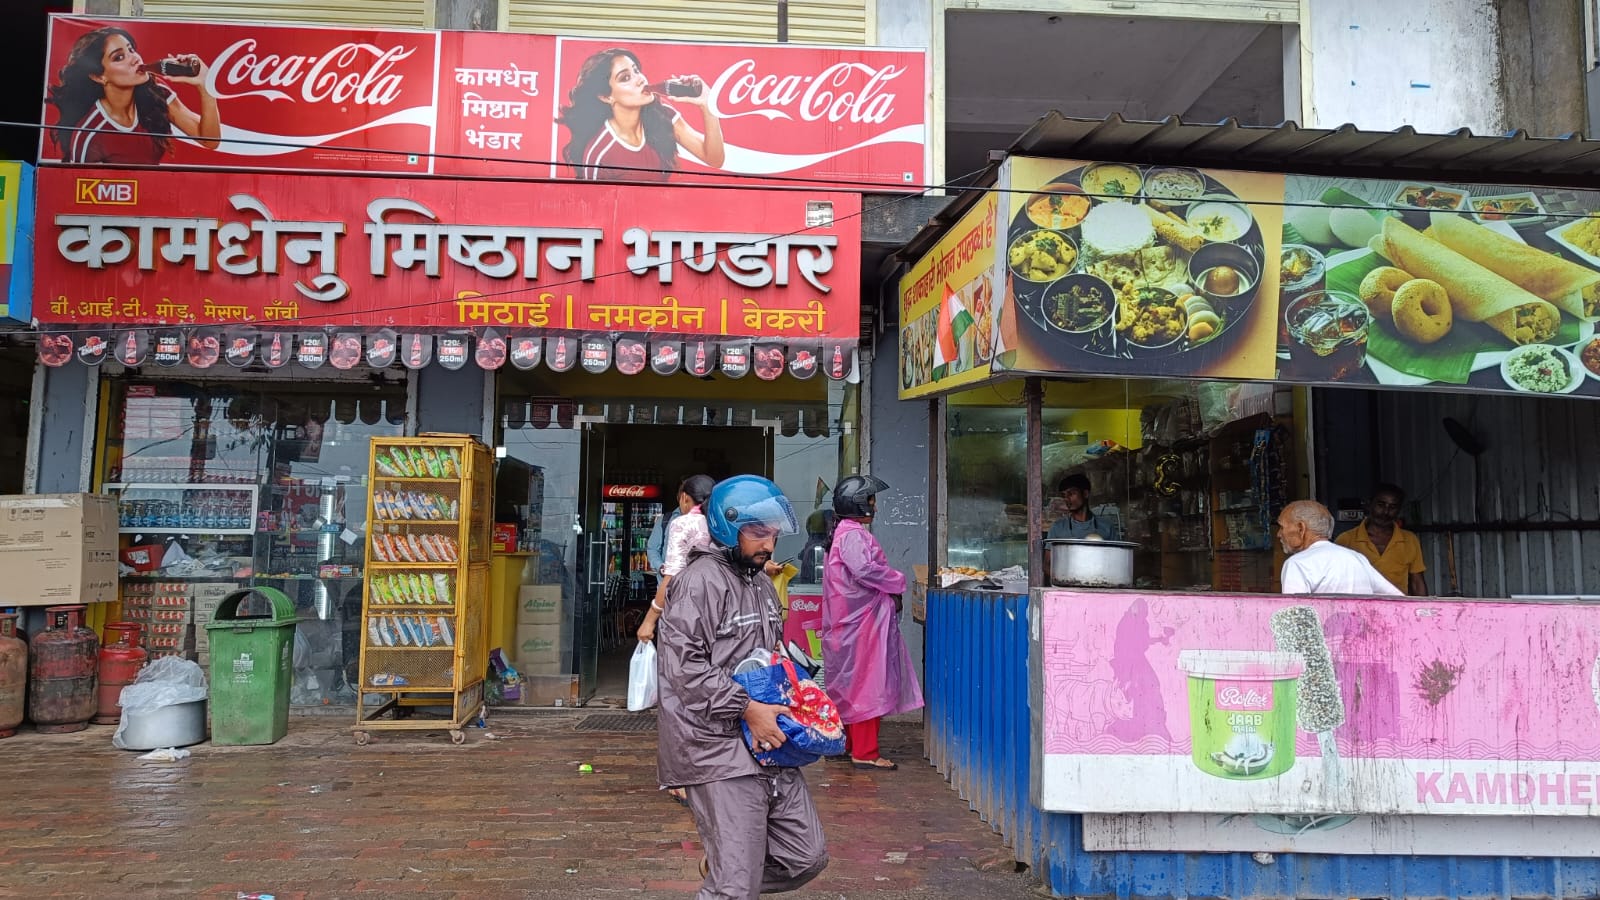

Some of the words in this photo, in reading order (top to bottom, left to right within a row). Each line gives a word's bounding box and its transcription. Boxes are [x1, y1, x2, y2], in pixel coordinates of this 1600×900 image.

[206, 38, 417, 105] Coca-Cola
[455, 62, 539, 97] कामधेनु
[708, 58, 907, 124] Coca-Cola
[465, 124, 523, 150] भंडार
[81, 182, 132, 204] KMB
[56, 194, 349, 302] कामधेनु
[365, 197, 603, 281] मिष्ठान
[623, 228, 837, 294] भण्डार
[457, 292, 555, 327] मिठाई
[588, 296, 705, 330] नमकीन
[743, 298, 826, 333] बेकरी
[609, 485, 645, 496] Coca-Cola
[1416, 771, 1600, 805] KAMDHE
